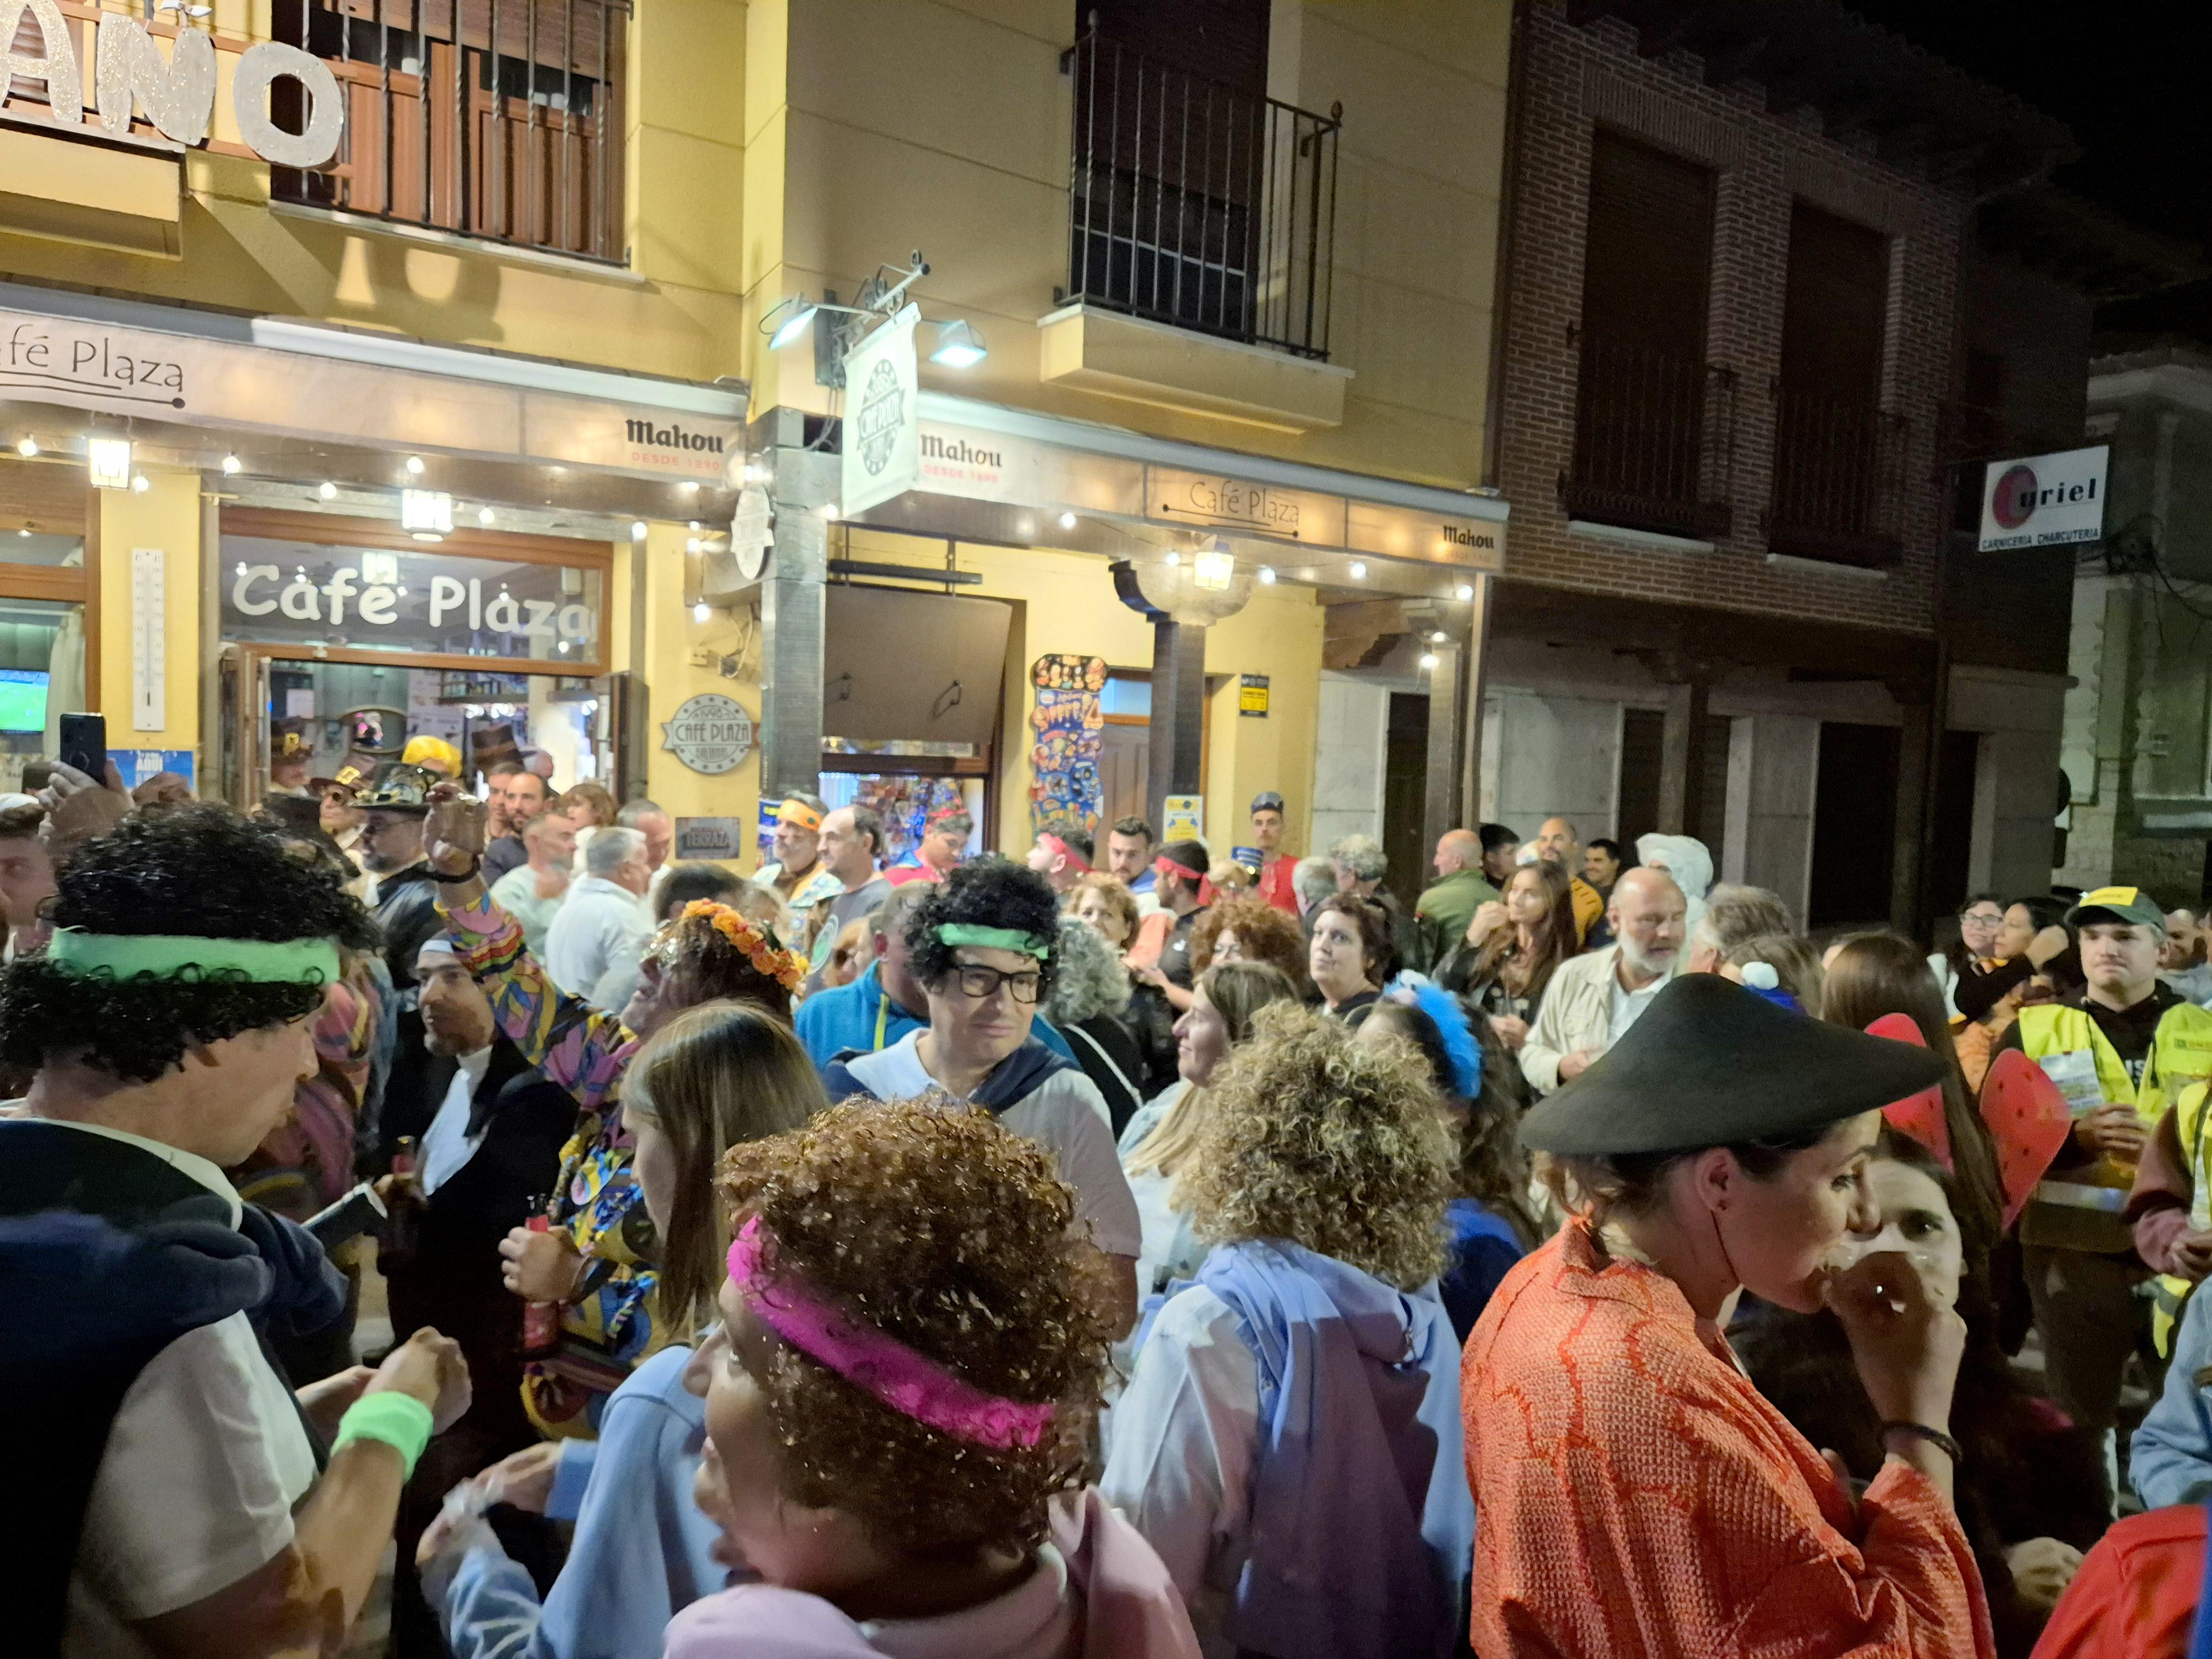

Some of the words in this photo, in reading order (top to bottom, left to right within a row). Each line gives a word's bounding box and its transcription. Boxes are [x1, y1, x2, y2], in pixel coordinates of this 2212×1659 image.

[0, 324, 49, 365] fé
[72, 337, 183, 392] Plaza
[625, 419, 724, 454] Mahou
[632, 452, 680, 466] DESDE
[688, 459, 720, 471] 1890
[921, 434, 1002, 468] Mahou
[925, 464, 964, 479] DESDE
[1190, 480, 1239, 514] Café
[1249, 488, 1300, 527] Plaza
[1443, 525, 1494, 549] Mahou
[2037, 528, 2099, 545] CHARCUTERIA
[233, 564, 398, 625] Café
[430, 575, 591, 637] Plaza
[711, 723, 749, 742] PLAZA
[684, 831, 731, 849] TERRAZA
